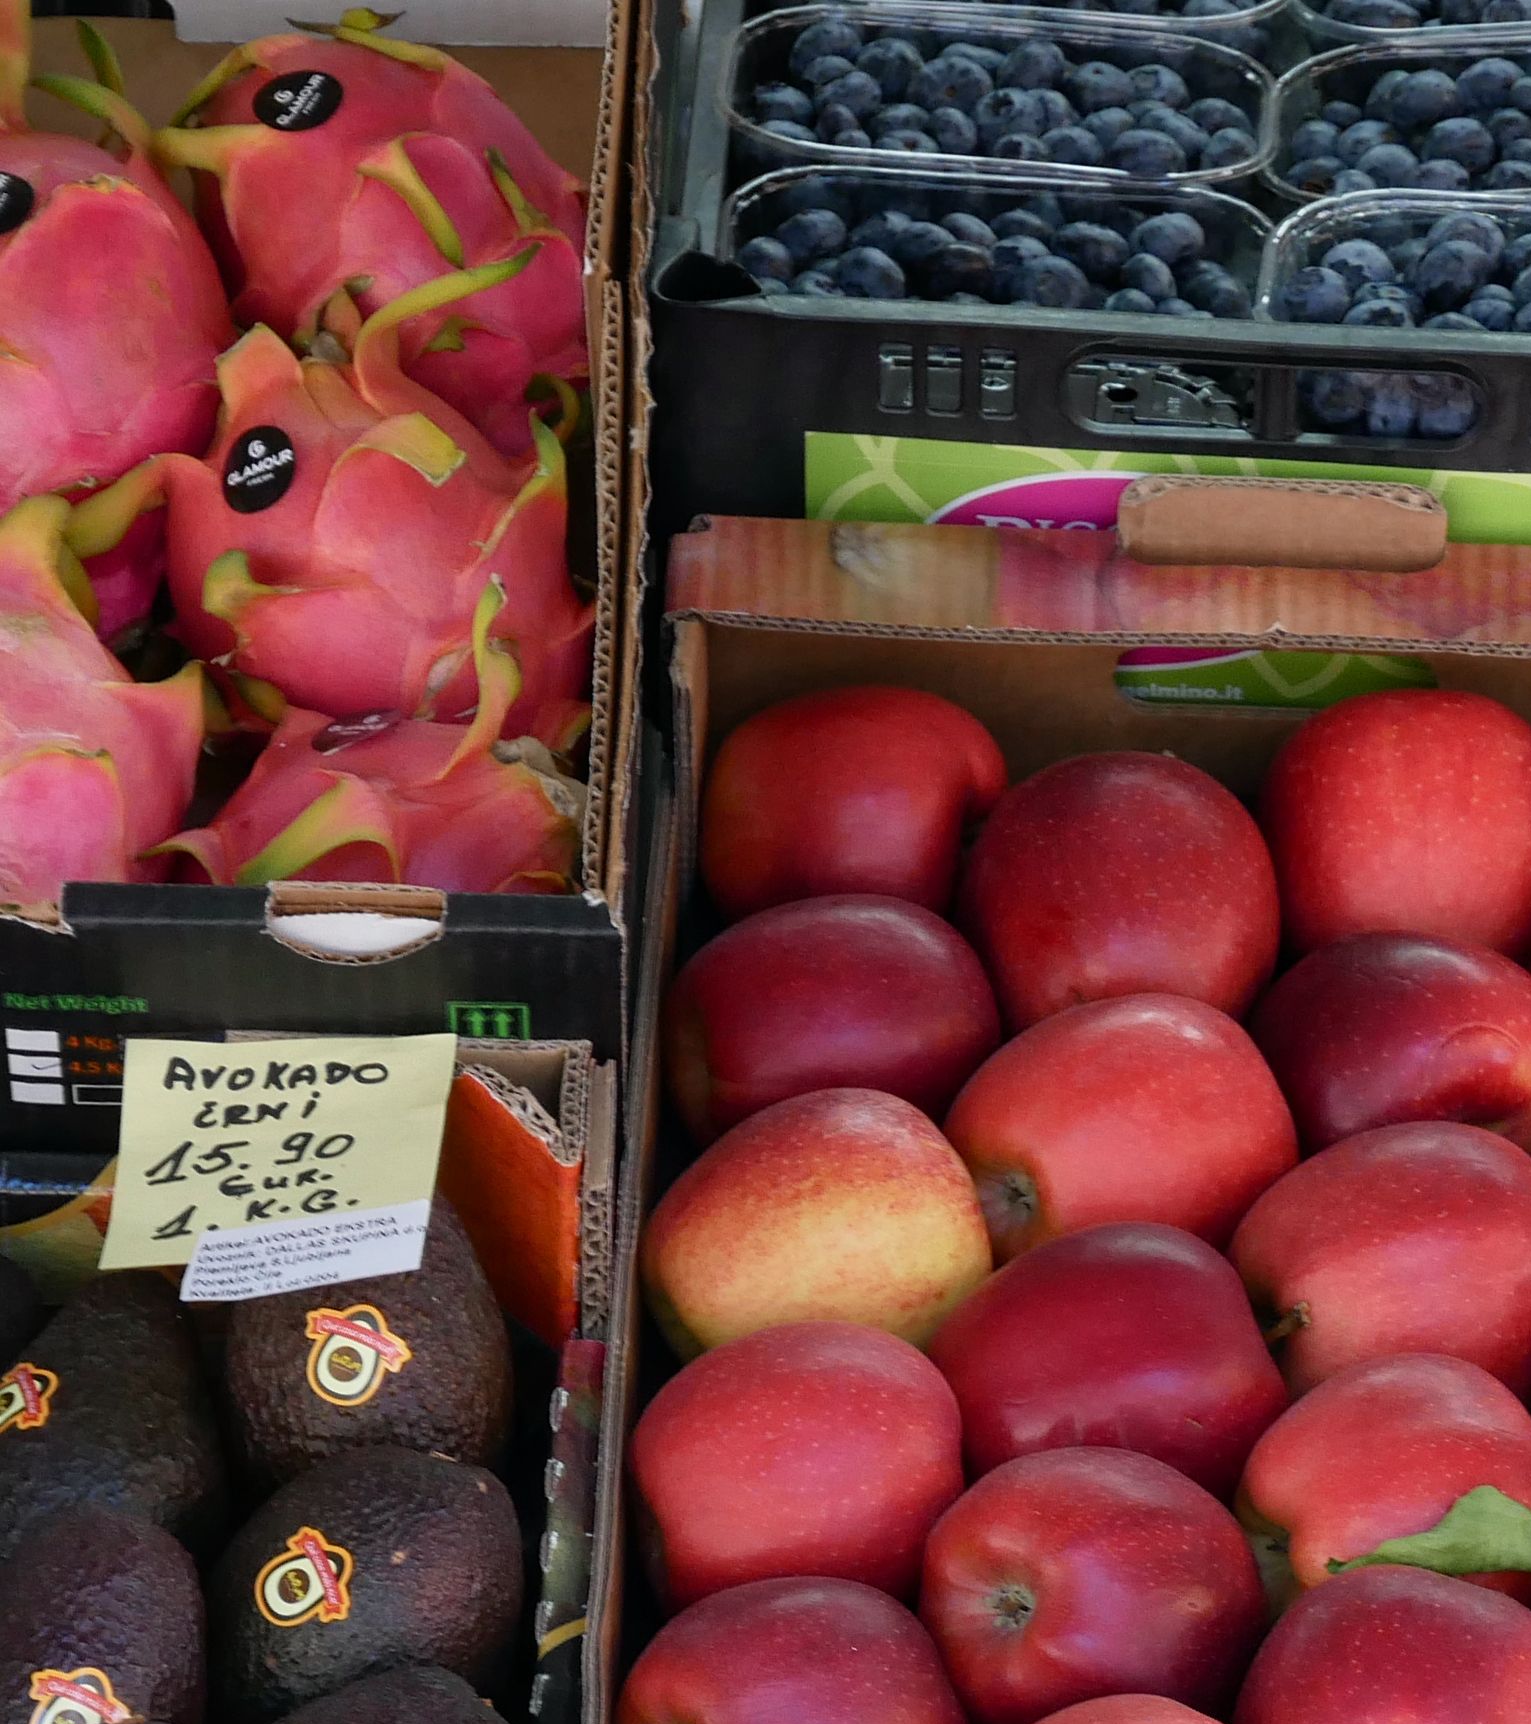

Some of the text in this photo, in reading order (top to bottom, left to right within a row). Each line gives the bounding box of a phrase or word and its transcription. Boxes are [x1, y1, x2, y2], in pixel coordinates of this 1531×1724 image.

[276, 74, 326, 126] GLAMOUR
[227, 448, 294, 486] GLAMOUR
[3, 992, 150, 1015] Net Weight
[163, 1056, 389, 1091] AVOKADO
